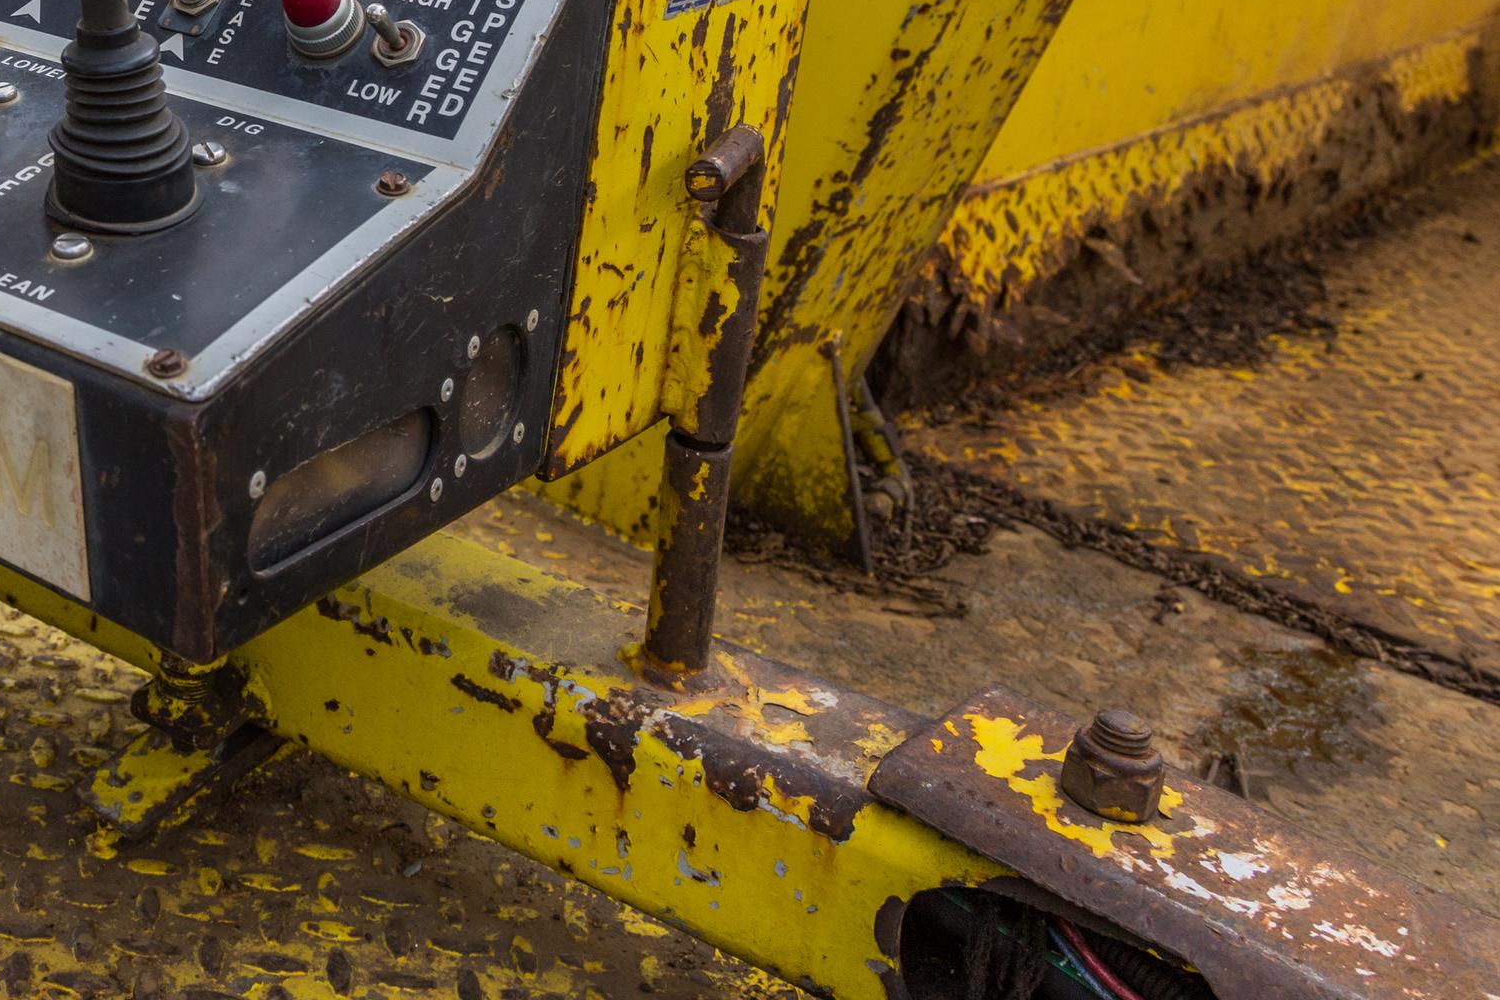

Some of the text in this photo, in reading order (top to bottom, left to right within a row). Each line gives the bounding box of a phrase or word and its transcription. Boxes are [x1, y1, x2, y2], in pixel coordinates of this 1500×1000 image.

[1, 56, 66, 80] LOWE
[346, 80, 402, 106] LOW
[216, 116, 264, 135] DIG
